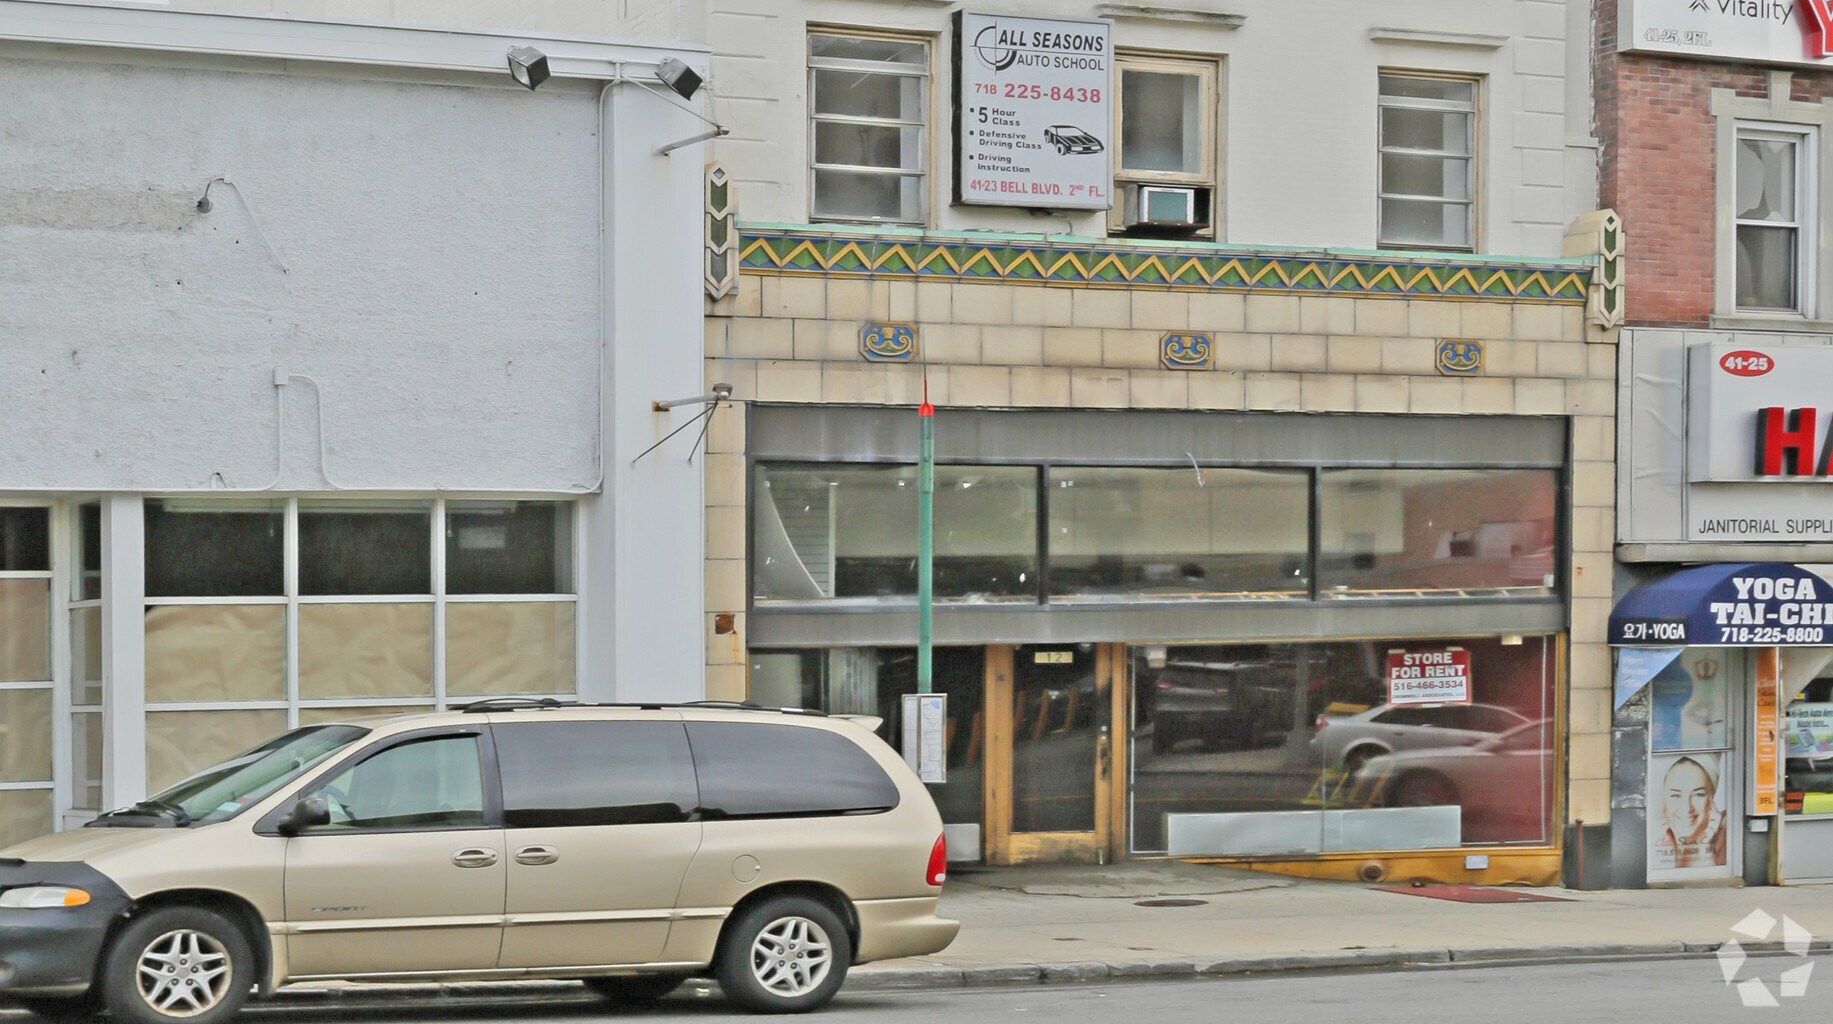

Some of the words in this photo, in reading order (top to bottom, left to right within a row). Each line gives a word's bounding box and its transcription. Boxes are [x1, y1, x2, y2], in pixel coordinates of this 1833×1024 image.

[998, 29, 1027, 47] ALL
[1032, 31, 1104, 52] SEASONS
[1017, 54, 1050, 68] AUTO
[1054, 56, 1104, 71] SCHOOL
[974, 82, 997, 95] 718
[1004, 83, 1101, 103] 225-8438
[978, 107, 988, 123] 5
[992, 108, 1016, 116] Hour
[992, 117, 1020, 126] Class
[979, 129, 1026, 139] Defensive
[979, 138, 1013, 149] Driving
[1016, 141, 1042, 150] Class
[978, 153, 1012, 164] Driving
[977, 163, 1031, 173] Instruction
[970, 179, 998, 192] 41-23
[1000, 180, 1028, 193] BELL
[1031, 182, 1063, 195] BLVD.
[1724, 356, 1769, 372] 41-25
[1754, 407, 1833, 476] H
[1699, 519, 1779, 534] JANITORIAL
[1732, 577, 1817, 600] YOGA
[1710, 602, 1833, 625] TAI-CHI
[1721, 627, 1824, 642] 718-225-8800
[1403, 652, 1452, 665] STORE
[1391, 666, 1421, 679] FOR
[1425, 664, 1465, 677] RENT
[1394, 680, 1463, 691] 516-466-3534
